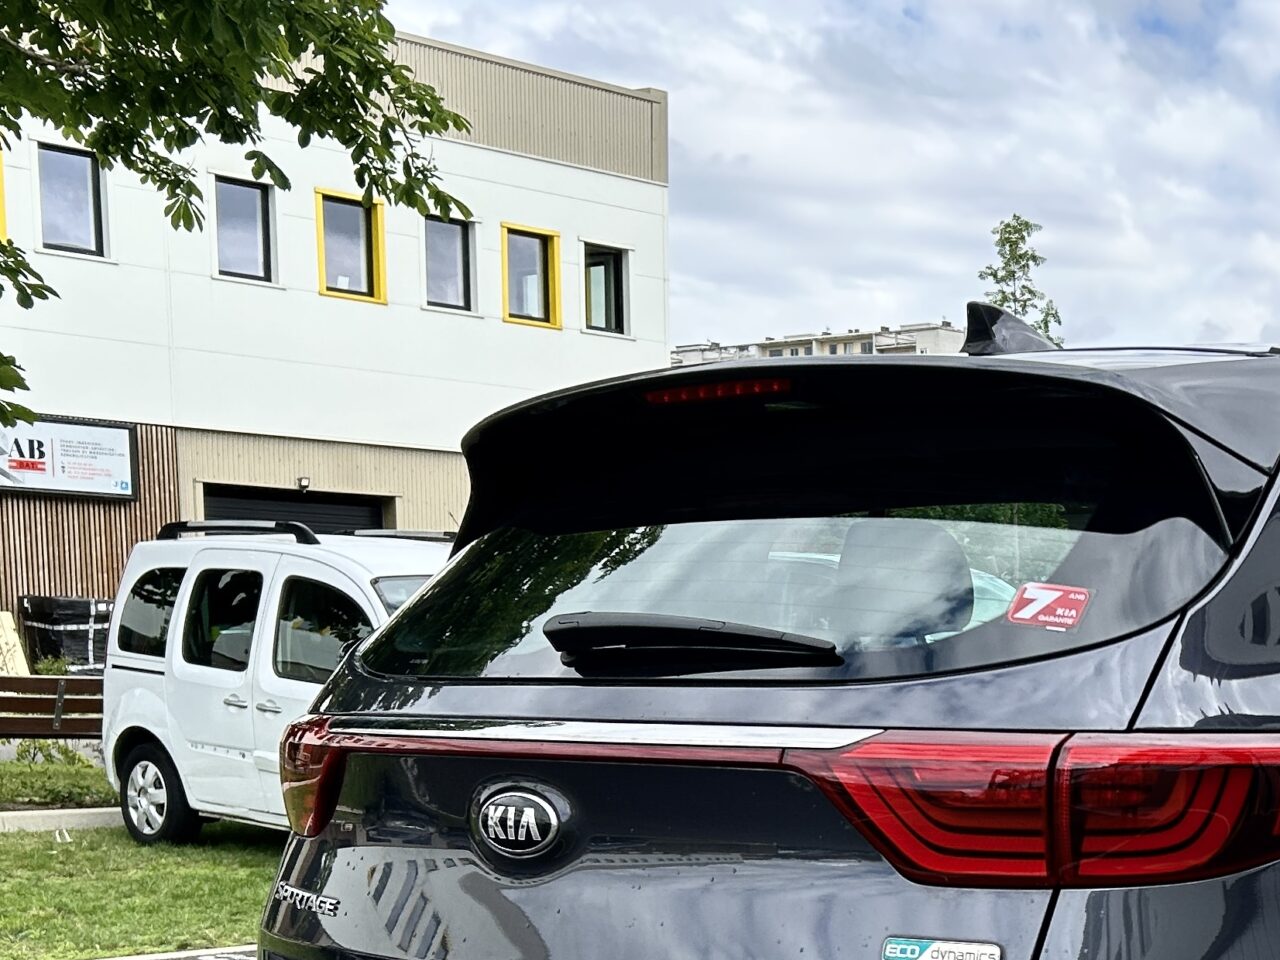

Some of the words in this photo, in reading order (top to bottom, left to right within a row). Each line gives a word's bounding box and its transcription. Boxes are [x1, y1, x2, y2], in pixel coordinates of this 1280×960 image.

[8, 437, 46, 460] AB
[1013, 586, 1064, 619] 7
[1055, 607, 1077, 618] KIA
[487, 805, 542, 841] KIA
[275, 881, 341, 917] SPORTAGE
[885, 943, 921, 959] ECO
